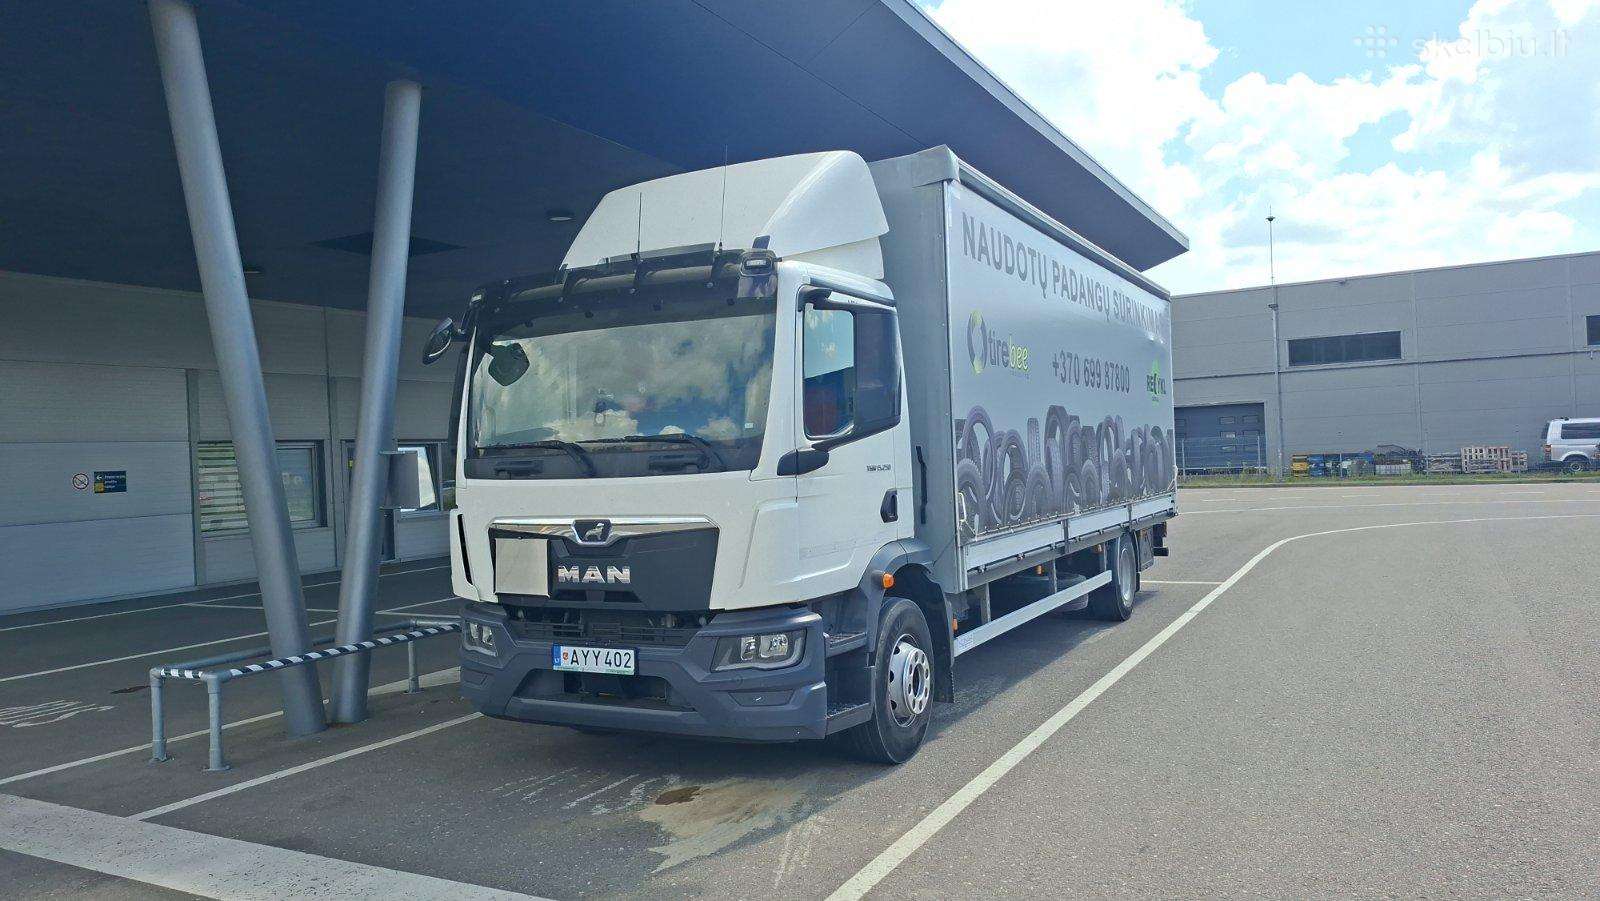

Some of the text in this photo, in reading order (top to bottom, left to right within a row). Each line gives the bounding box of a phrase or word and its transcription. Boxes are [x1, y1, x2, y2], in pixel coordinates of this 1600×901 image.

[962, 211, 1048, 299] NAUDOTŲ
[1052, 260, 1111, 322] PADANGŲ
[988, 329, 1029, 371] tirebee
[1052, 350, 1131, 393] +370 699 87800
[557, 565, 631, 584] MAN
[570, 649, 632, 669] AYY 402
